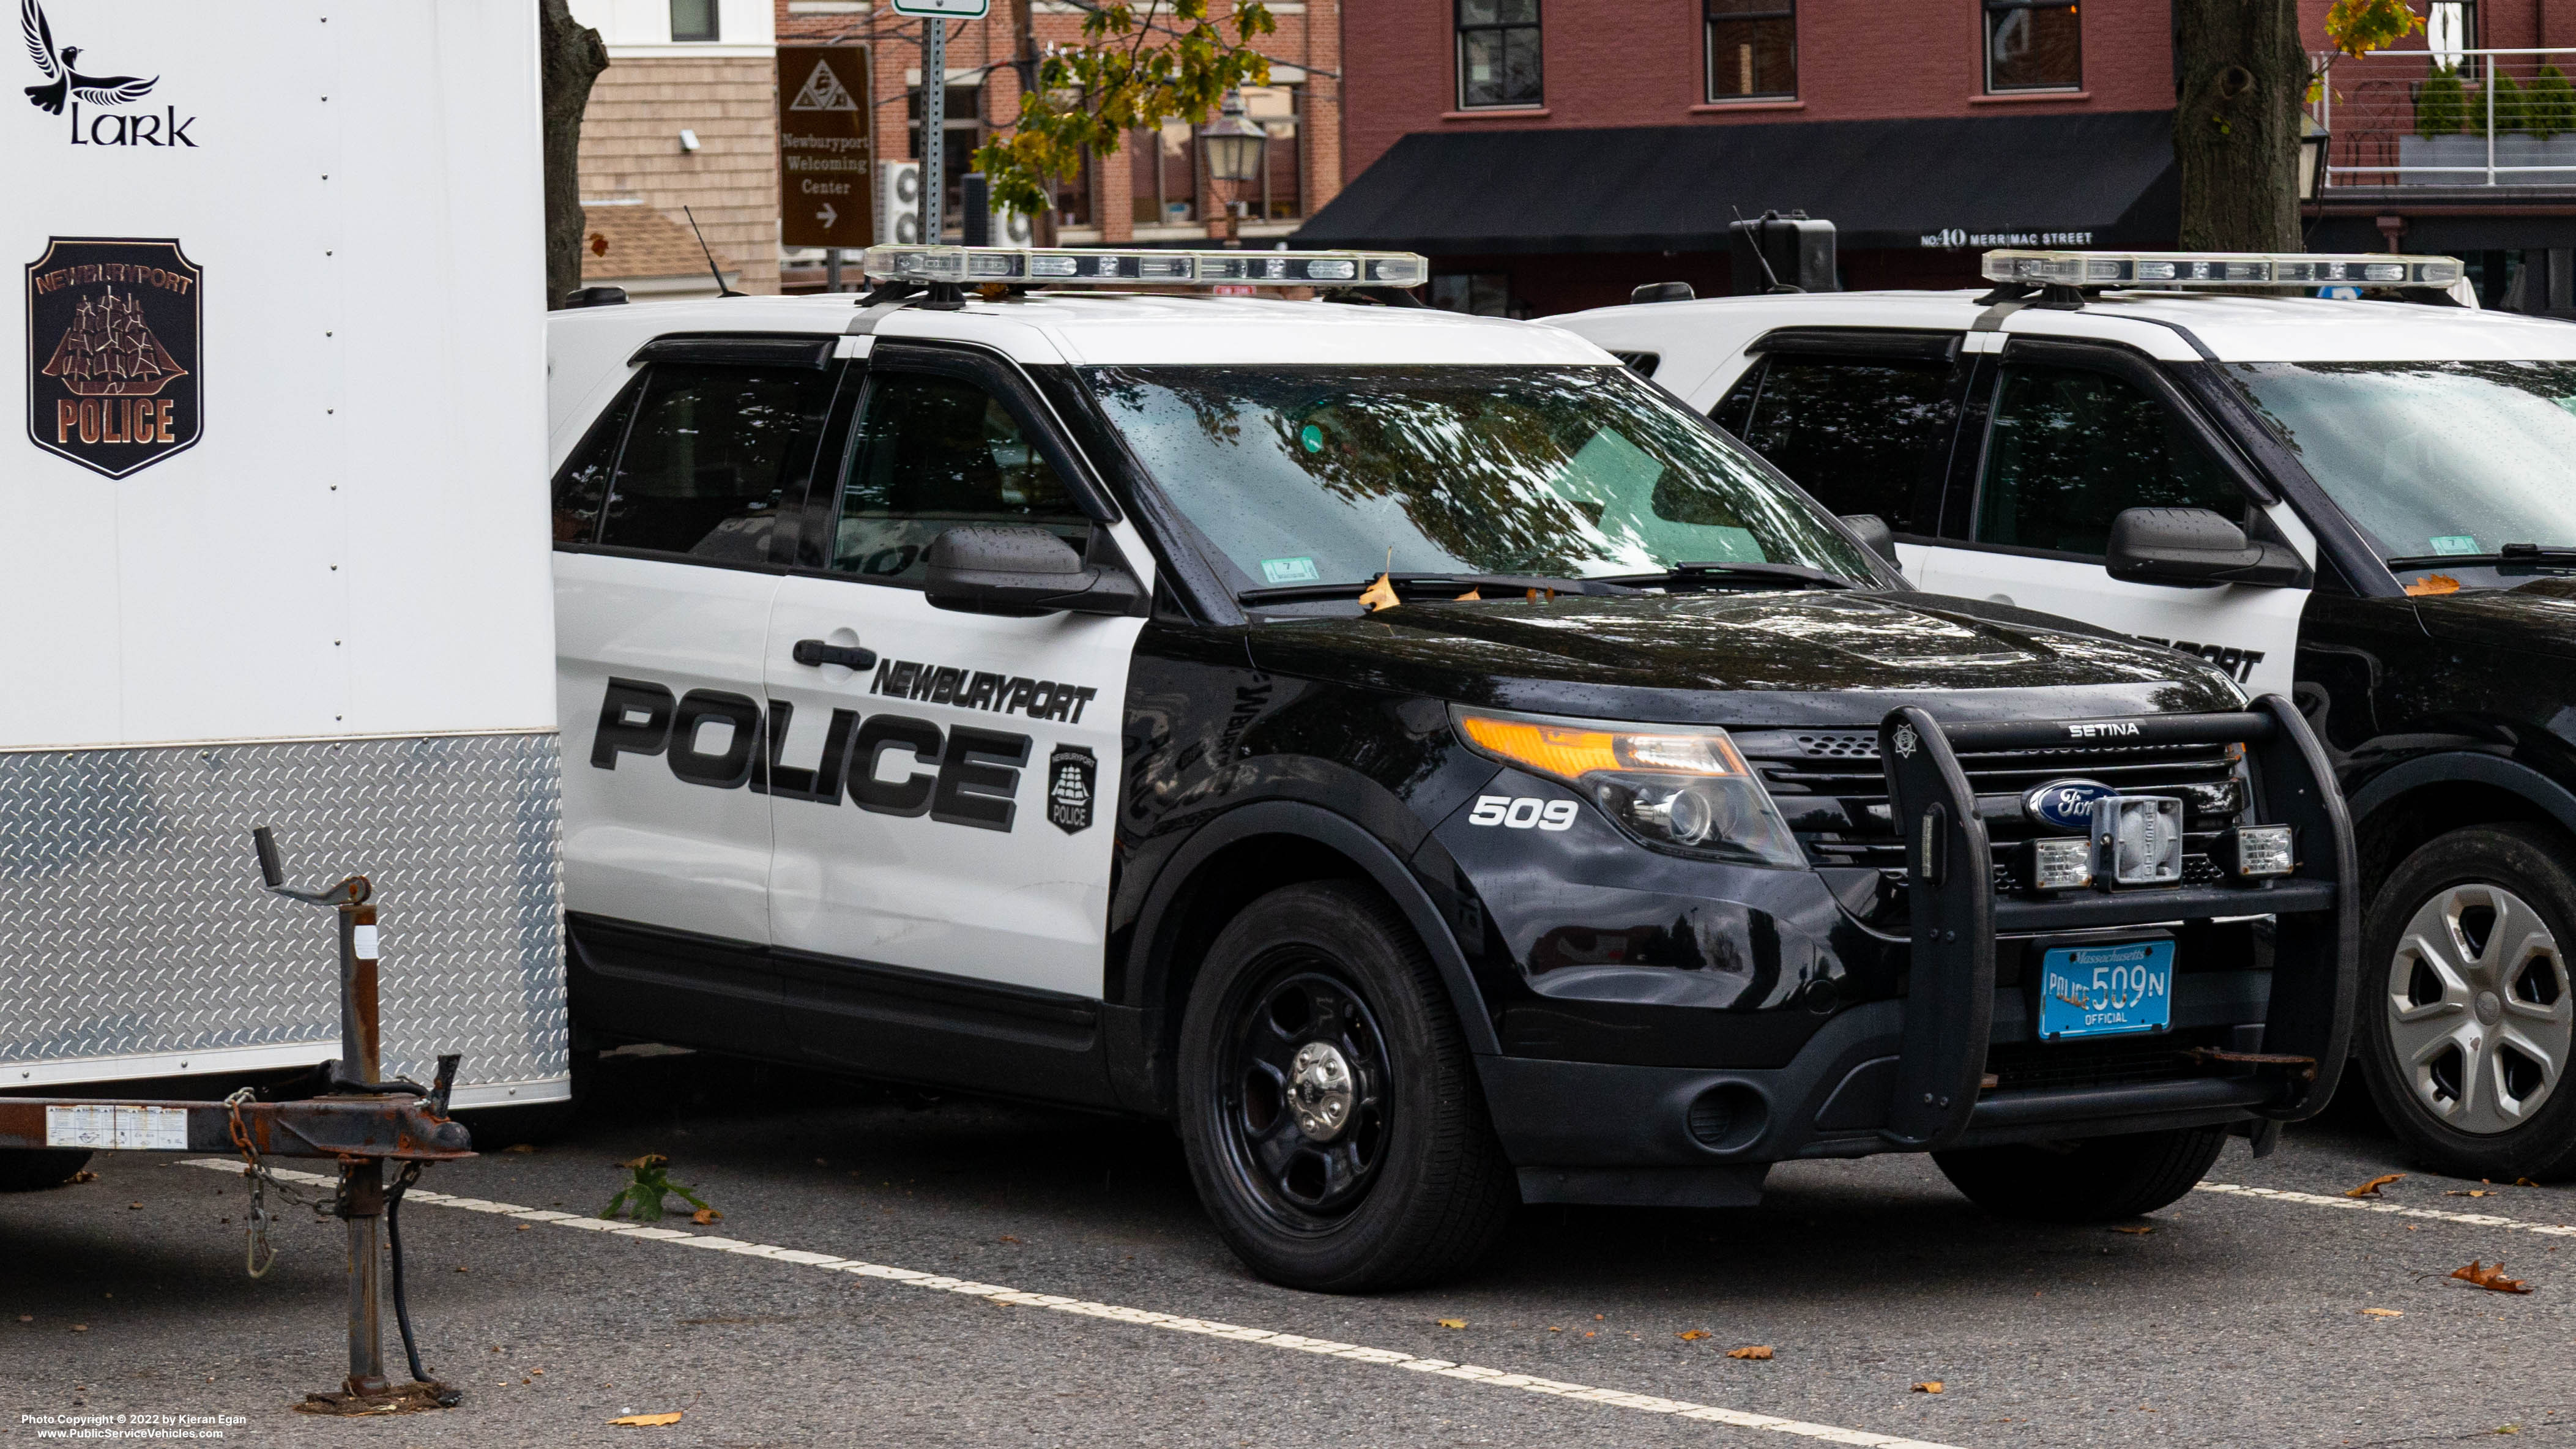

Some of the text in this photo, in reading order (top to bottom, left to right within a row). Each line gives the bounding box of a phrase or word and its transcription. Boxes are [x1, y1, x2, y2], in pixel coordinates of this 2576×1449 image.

[783, 133, 869, 152] Newburyport
[787, 155, 868, 174] Welcoming
[802, 179, 851, 194] Center
[1970, 234, 2038, 245] MERRIMAC
[2042, 232, 2093, 244] STREET
[35, 263, 194, 295] NEWBURYPORT
[58, 398, 175, 444] POLICE
[869, 658, 1098, 724] NEWBURYPORT
[2068, 722, 2140, 738] SETINA
[590, 676, 1033, 833] POLICE
[1052, 752, 1095, 768] NEWBURYPORT
[1053, 804, 1086, 826] POLICE
[1469, 795, 1579, 831] 509
[2075, 949, 2145, 964] Massachusetts
[2049, 972, 2090, 1011] POLICE
[2085, 1012, 2128, 1026] OFFICIAL
